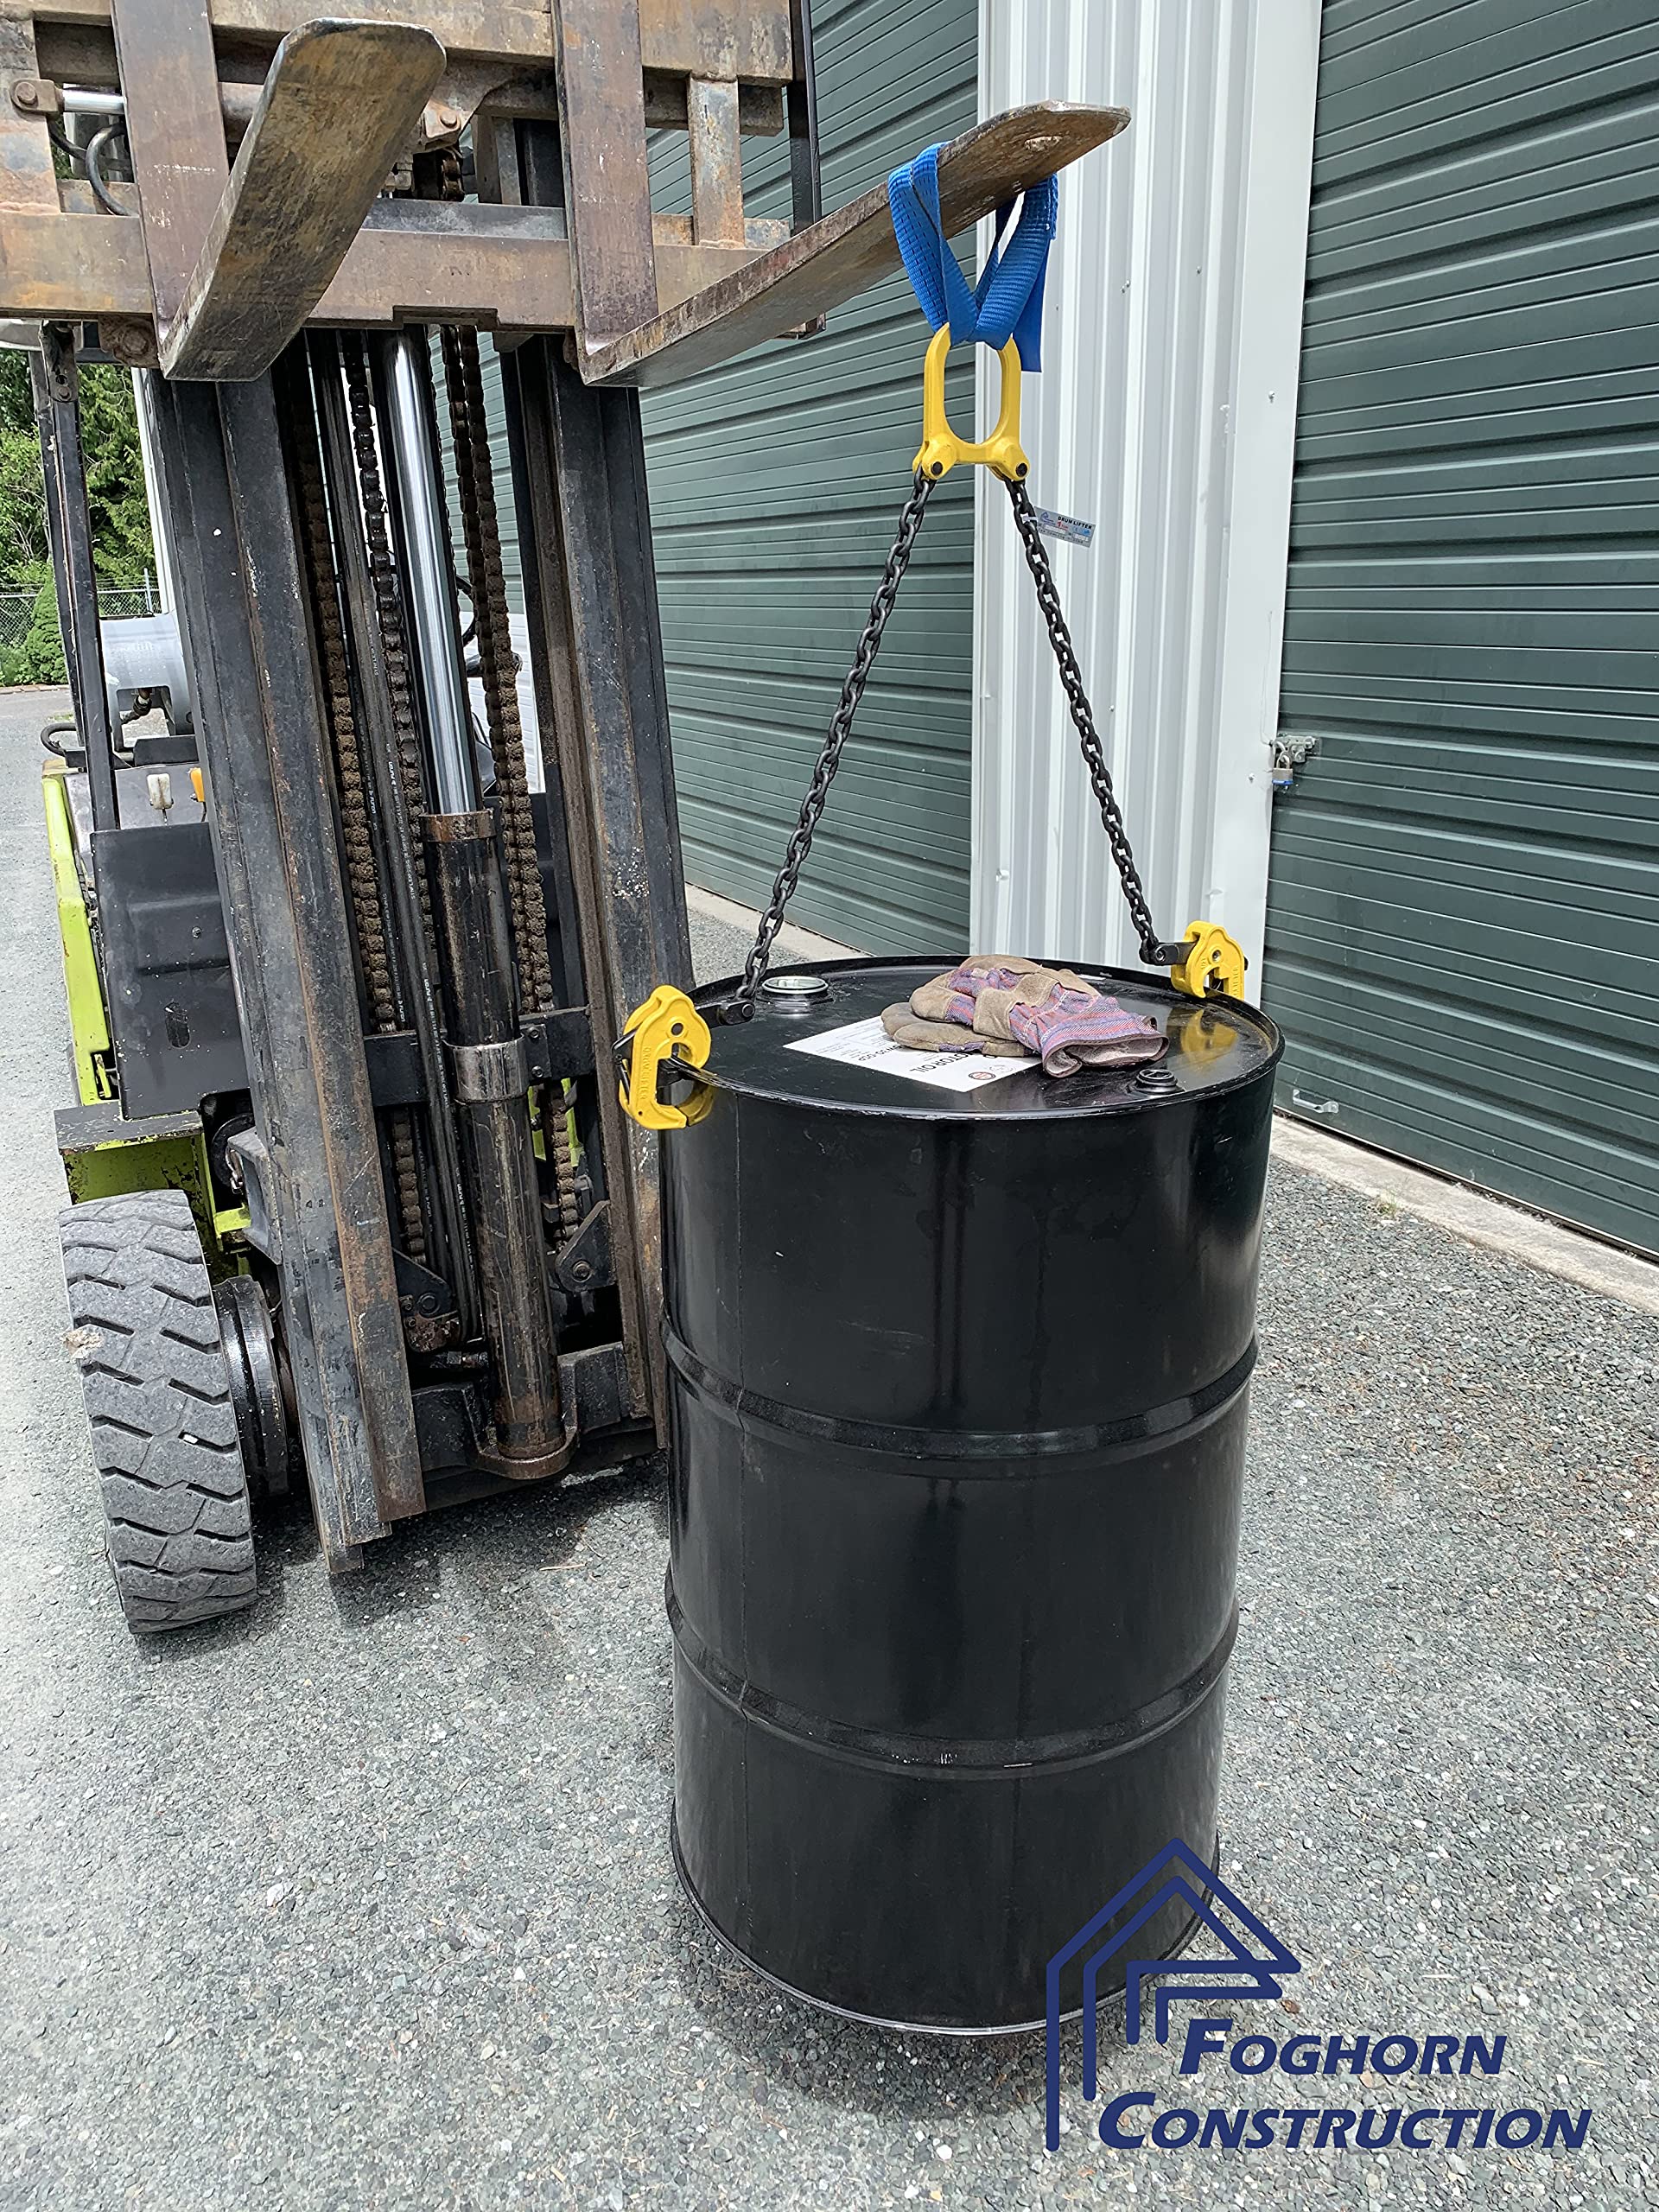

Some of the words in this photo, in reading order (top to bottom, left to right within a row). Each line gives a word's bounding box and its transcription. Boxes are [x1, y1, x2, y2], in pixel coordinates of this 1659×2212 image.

[1058, 516, 1073, 524] DRUM
[931, 1052, 971, 1066] OTOR
[909, 1064, 937, 1072] OIL
